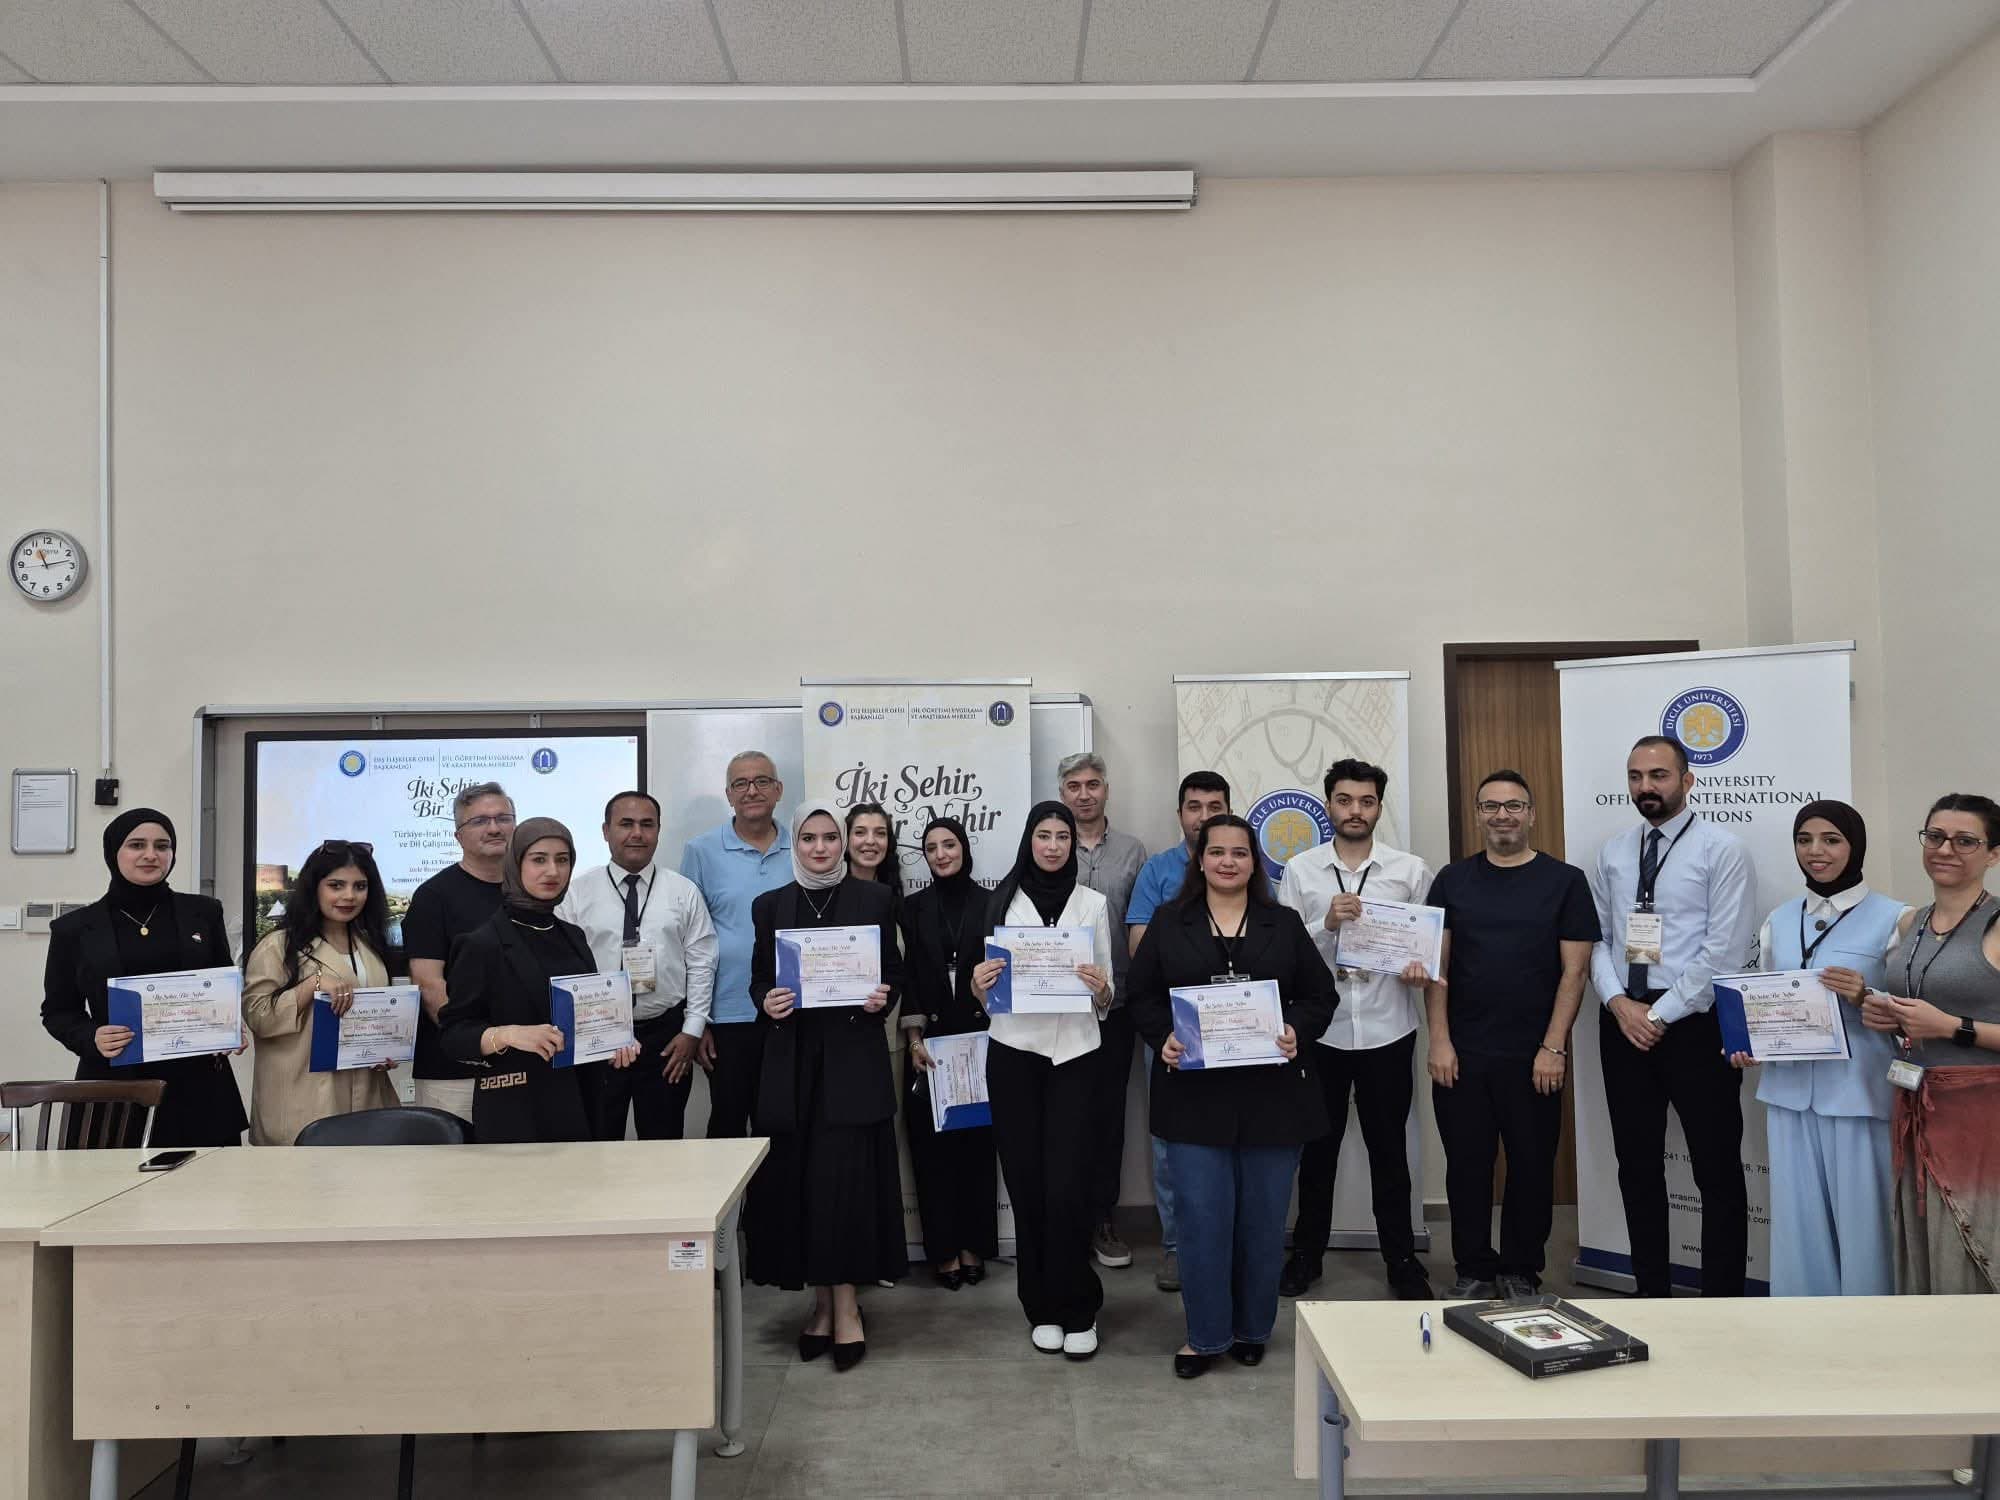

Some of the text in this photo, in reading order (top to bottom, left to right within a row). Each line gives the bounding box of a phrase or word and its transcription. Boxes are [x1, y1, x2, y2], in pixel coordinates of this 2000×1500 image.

[43, 536, 53, 545] 12
[24, 548, 33, 556] 10
[65, 549, 72, 557] 2
[69, 562, 75, 570] 3
[29, 582, 37, 590] 7
[1693, 753, 1713, 761] 1973
[835, 761, 888, 808] İki
[1696, 775, 1776, 787] NIVERSITY
[407, 775, 435, 800] İki
[1595, 791, 1822, 806] OFFI NTERNATIONAL
[413, 799, 445, 818] Bir
